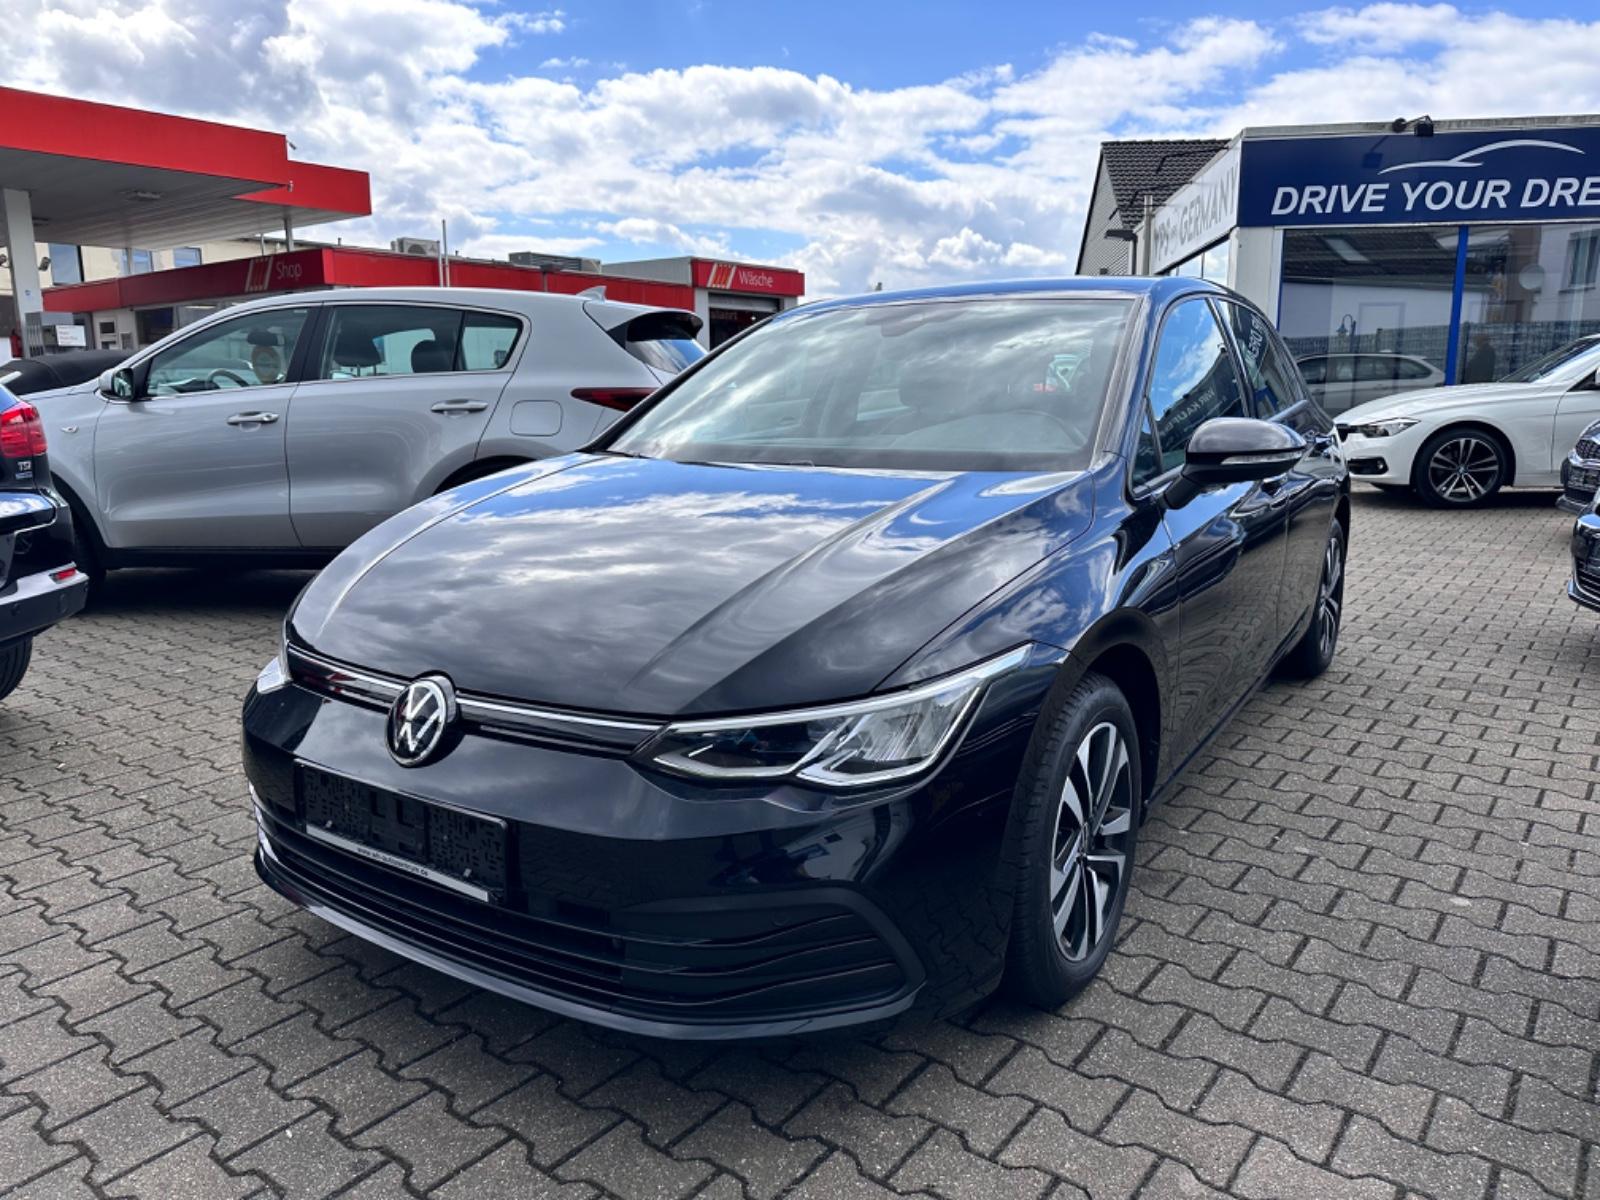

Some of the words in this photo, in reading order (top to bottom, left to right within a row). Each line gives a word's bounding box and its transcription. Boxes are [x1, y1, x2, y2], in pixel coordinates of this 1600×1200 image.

[1271, 183, 1390, 215] DRIVE
[1402, 179, 1512, 211] YOUR
[1519, 176, 1600, 208] DRE
[275, 261, 303, 281] Shop
[738, 269, 774, 288] Wäsche
